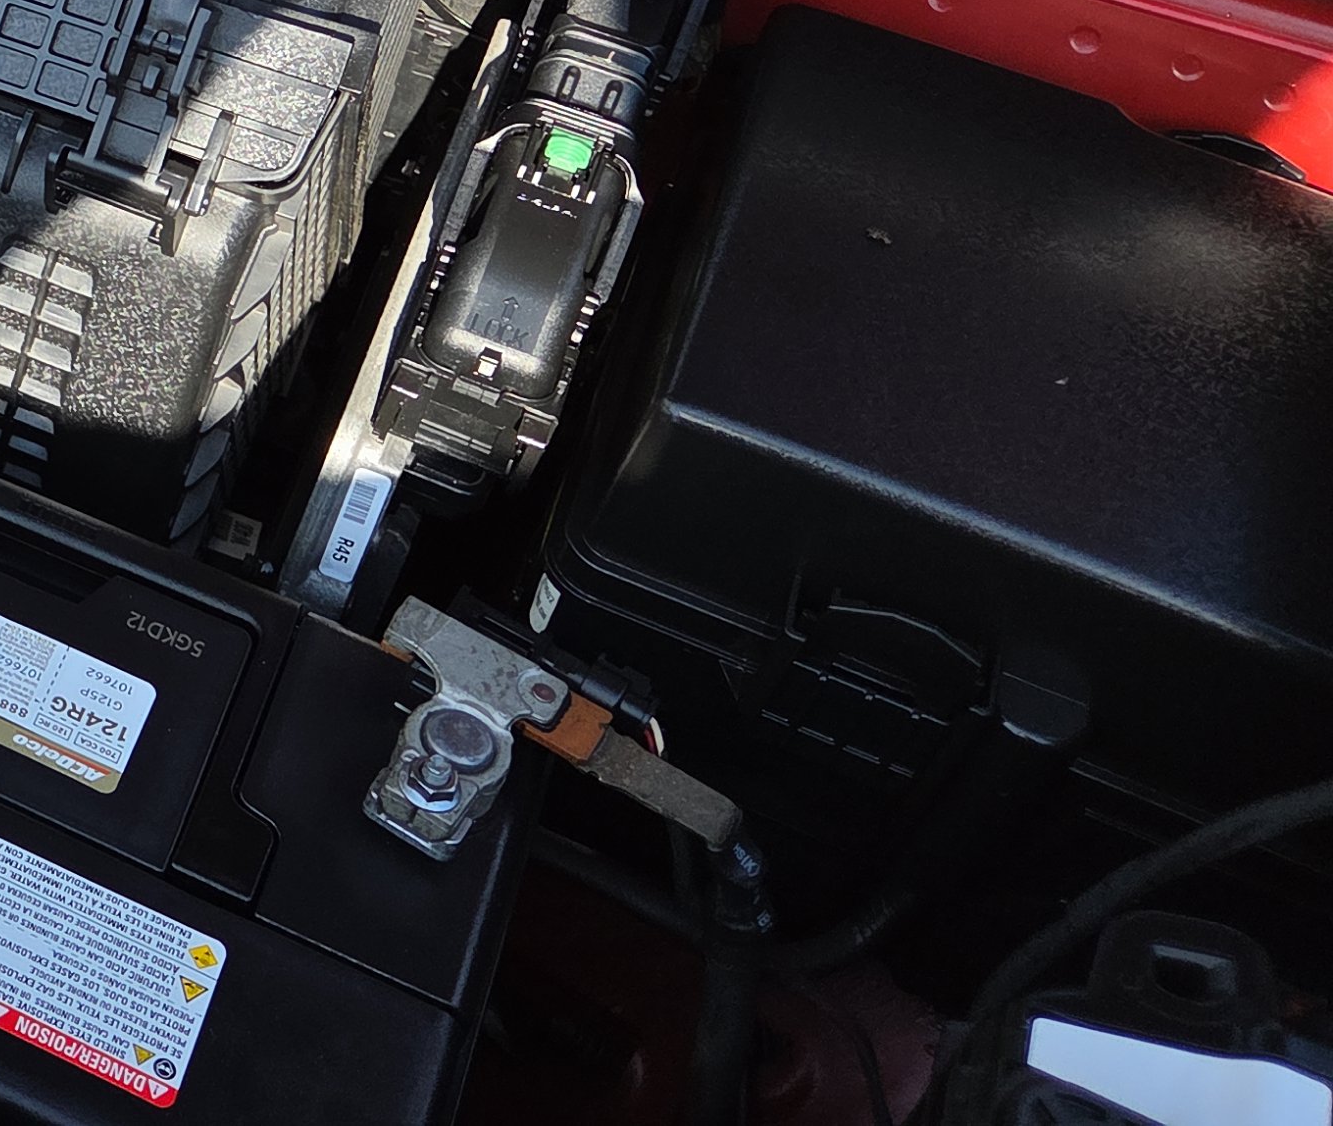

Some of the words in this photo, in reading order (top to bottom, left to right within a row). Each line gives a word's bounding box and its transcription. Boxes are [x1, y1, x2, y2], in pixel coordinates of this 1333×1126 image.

[332, 536, 355, 564] R45
[125, 610, 206, 659] 5GKD12
[83, 665, 135, 696] 107662
[78, 683, 124, 712] G125P
[36, 716, 51, 728] RC
[47, 692, 132, 744] 124RG
[50, 723, 68, 736] 120
[77, 735, 99, 751] CCA
[97, 744, 117, 759] 700
[9, 730, 106, 786] ACDelco
[3, 844, 25, 860] CON
[23, 853, 105, 898] INMEDIATAMENTE
[4, 884, 43, 909] CEGUERA
[40, 885, 68, 904] WITH
[62, 883, 90, 903] L'EAU
[104, 891, 131, 910] OJOS
[6, 910, 20, 924] OR
[20, 904, 34, 917] LA
[40, 901, 75, 924] CAUSAR
[66, 897, 129, 933] IMMEDIATELY
[97, 900, 124, 919] YEUX
[122, 911, 142, 927] LES
[129, 903, 149, 919] LOS
[31, 909, 65, 932] CAUSER
[73, 916, 102, 937] PUEDE
[148, 912, 193, 939] ENJUAGE
[62, 924, 86, 942] PEUT
[128, 926, 153, 944] EYES
[140, 920, 176, 943] RINSER
[58, 935, 87, 956] CAUSE
[84, 934, 141, 969] SULFURIQUE
[154, 939, 185, 960] FLUSH
[175, 936, 189, 950] SE
[85, 948, 105, 965] CAN
[103, 957, 128, 976] ACID
[48, 960, 81, 983] GASES
[88, 967, 97, 978] O
[139, 961, 176, 986] L'ACIDE
[34, 980, 56, 998] GAZ
[80, 975, 101, 992] LOS
[126, 968, 172, 997] SULFURIC
[18, 988, 33, 1001] OR
[55, 990, 74, 1007] LES
[64, 982, 99, 1005] RENDRE
[126, 985, 162, 1008] CAUSAR
[14, 997, 66, 1030] EXPLOSIVE
[33, 995, 81, 1025] BLINDNESS
[98, 998, 113, 1012] OU
[128, 999, 149, 1016] LOS
[160, 1001, 196, 1025] PUEDEN
[101, 1013, 120, 1029] LES
[111, 1004, 149, 1029] BLESSER
[147, 1008, 192, 1036] PROTEJA
[80, 1018, 110, 1039] CAUSE
[147, 1022, 188, 1048] PEUVENT
[91, 1035, 127, 1060] SHIELD
[110, 1033, 131, 1049] CAN
[13, 1013, 148, 1093] DANGER/POISON
[168, 1045, 183, 1060] SE
